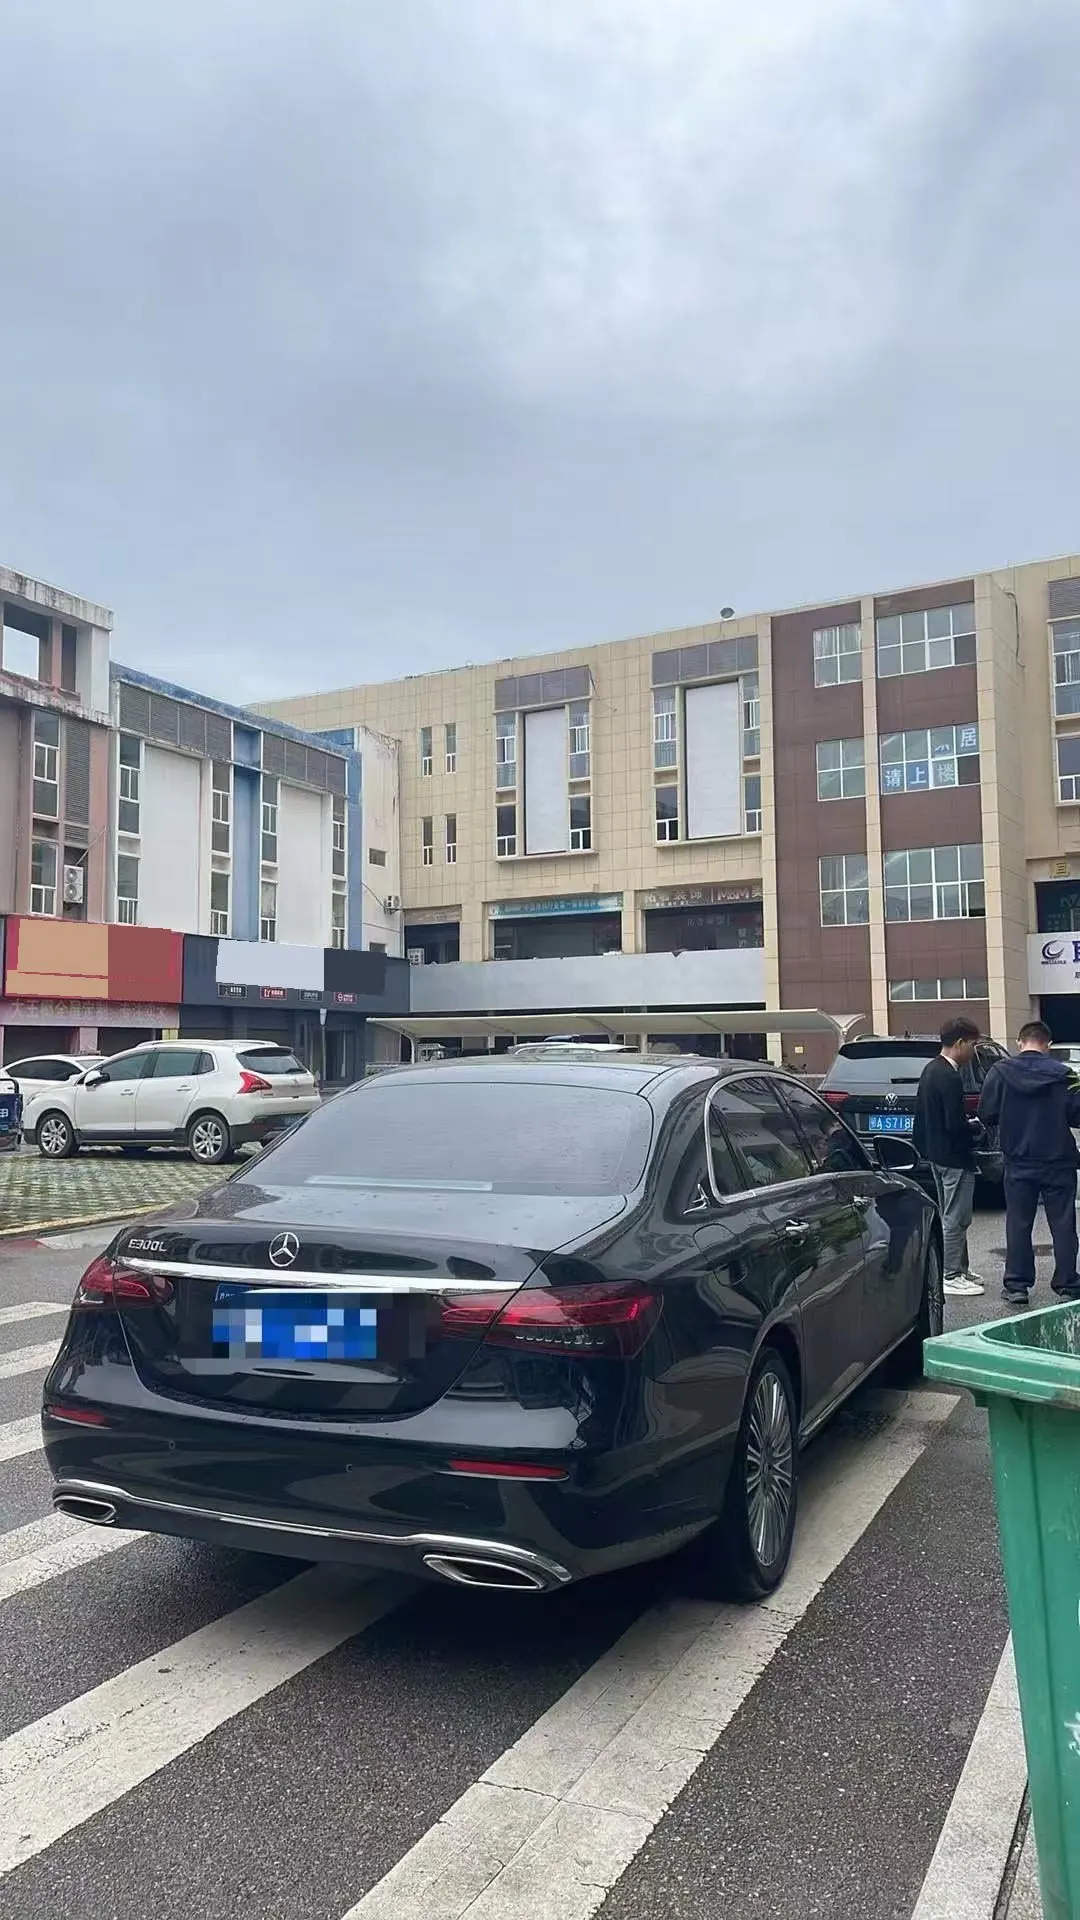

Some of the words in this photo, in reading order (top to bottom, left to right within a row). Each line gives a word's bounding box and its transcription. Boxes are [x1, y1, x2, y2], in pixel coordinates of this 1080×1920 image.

[885, 763, 955, 787] 请上楼
[128, 1238, 167, 1252] E300L
